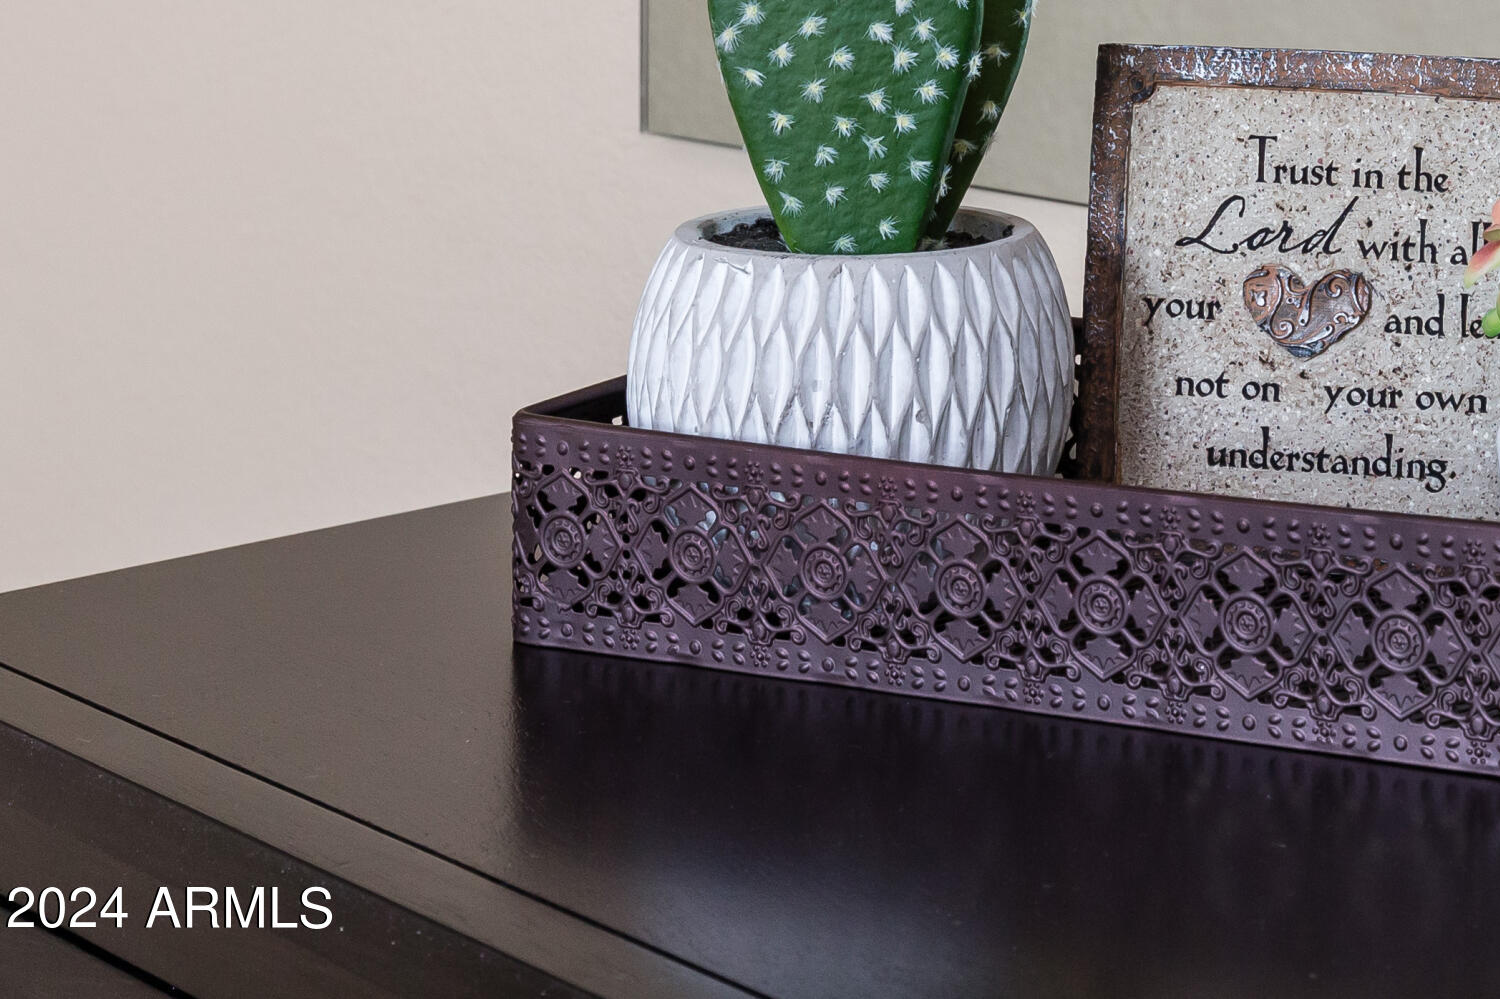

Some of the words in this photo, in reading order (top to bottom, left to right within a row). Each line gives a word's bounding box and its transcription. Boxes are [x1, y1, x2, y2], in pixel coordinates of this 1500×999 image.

[1248, 134, 1339, 187] Trust
[1351, 157, 1385, 190] in
[1397, 145, 1449, 193] the
[1174, 194, 1360, 255] Lord
[1356, 218, 1439, 265] with
[1142, 296, 1222, 327] your
[1384, 292, 1446, 339] and
[1174, 371, 1231, 399] not
[1241, 380, 1282, 403] on
[1323, 385, 1404, 415] your
[1414, 390, 1488, 415] own
[1206, 425, 1457, 494] understanding.
